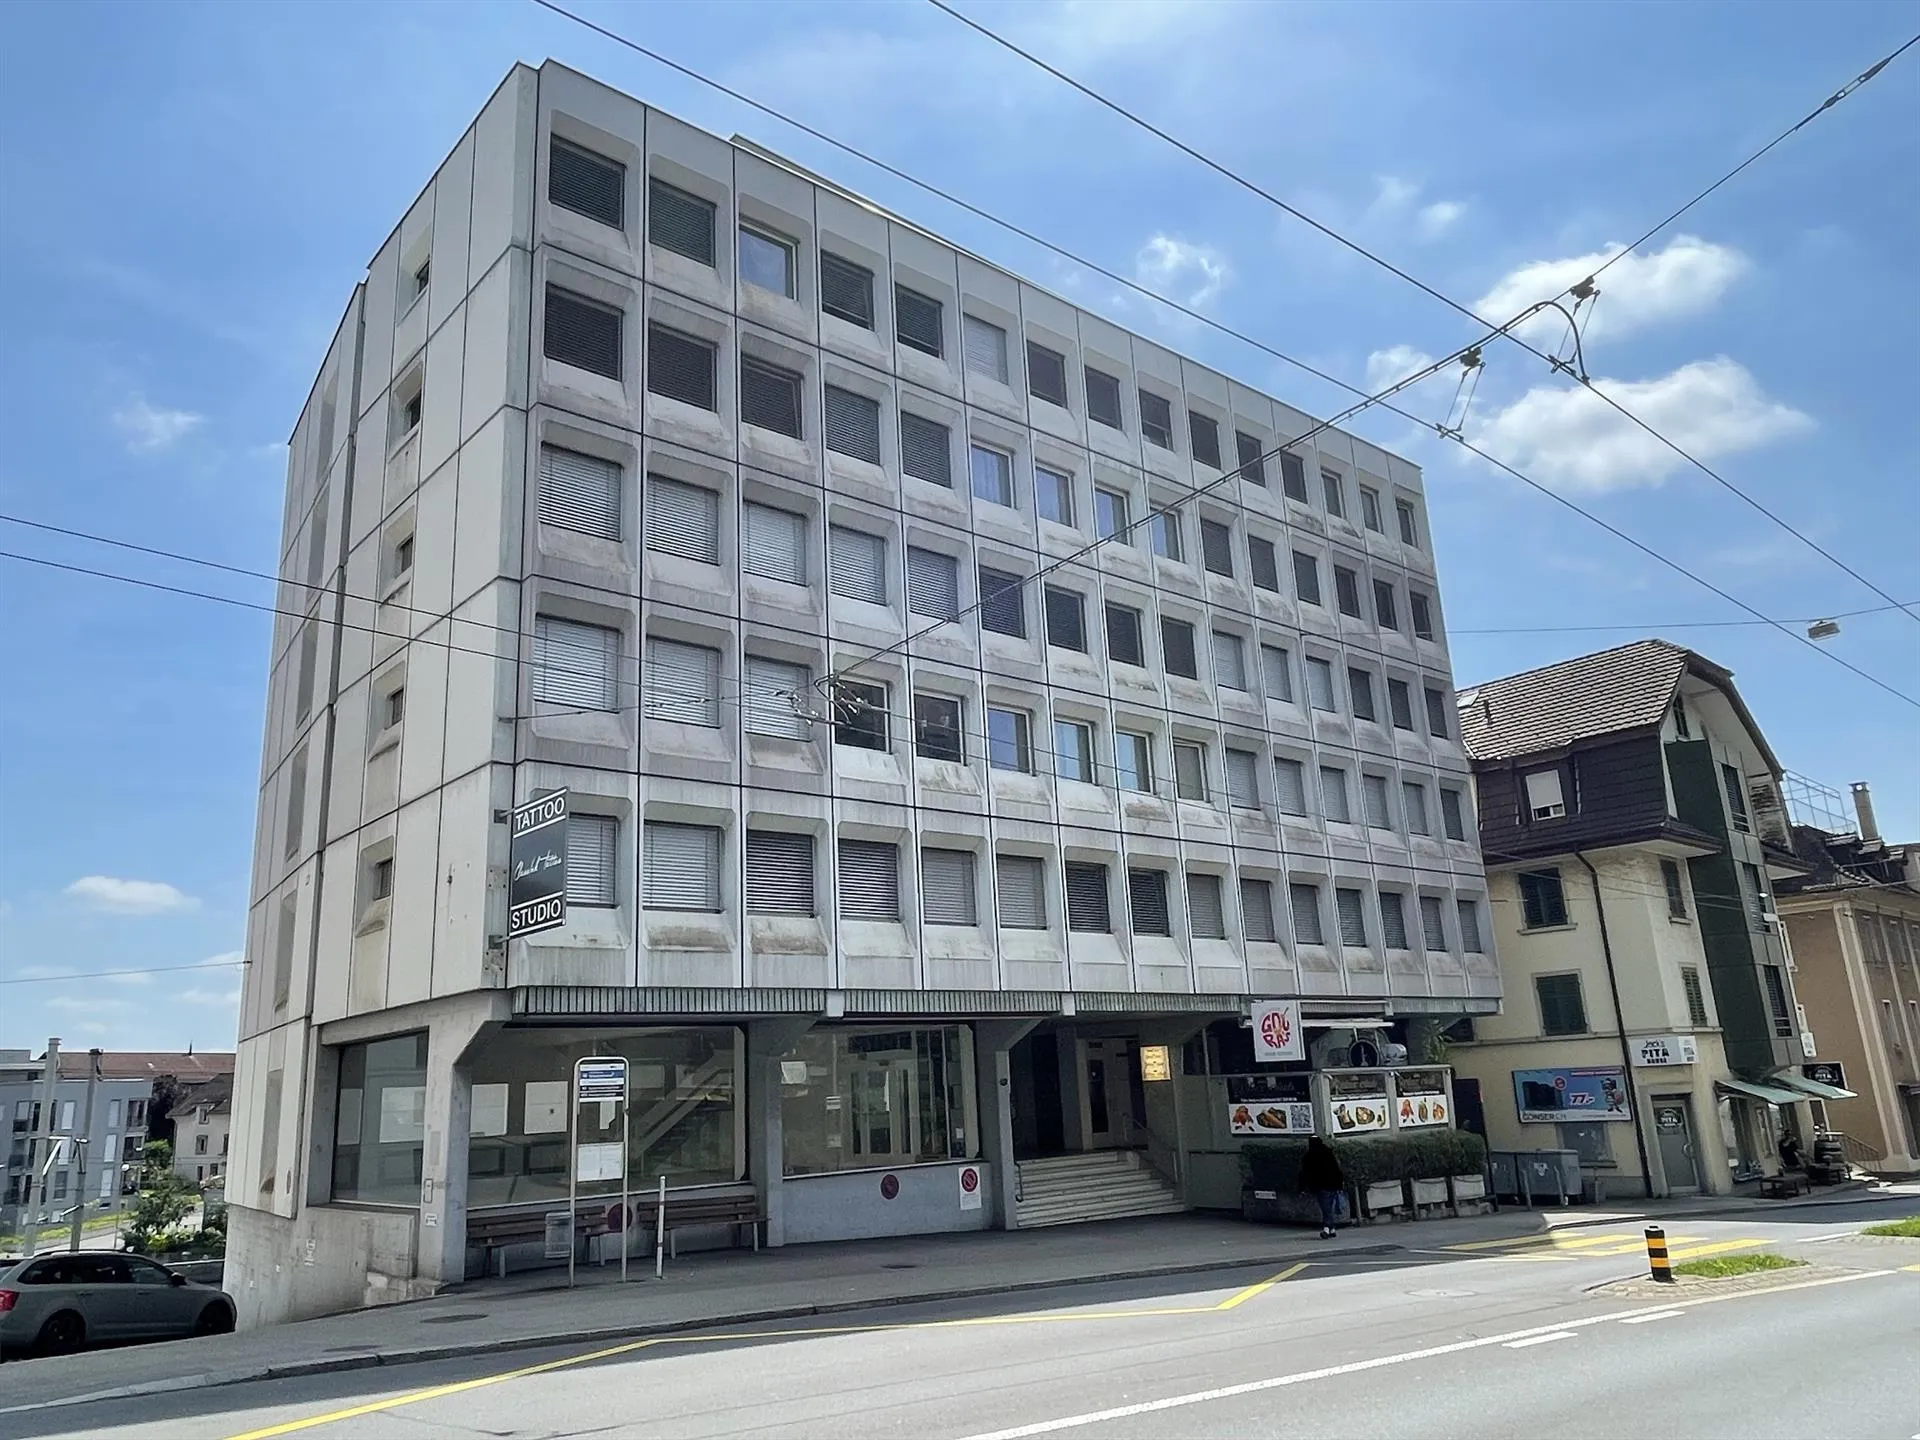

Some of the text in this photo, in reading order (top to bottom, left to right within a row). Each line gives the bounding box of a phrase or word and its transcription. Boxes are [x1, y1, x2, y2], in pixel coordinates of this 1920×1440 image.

[515, 797, 565, 831] TATTOO
[511, 899, 561, 929] STUDIO
[1641, 1048, 1670, 1059] PITA
